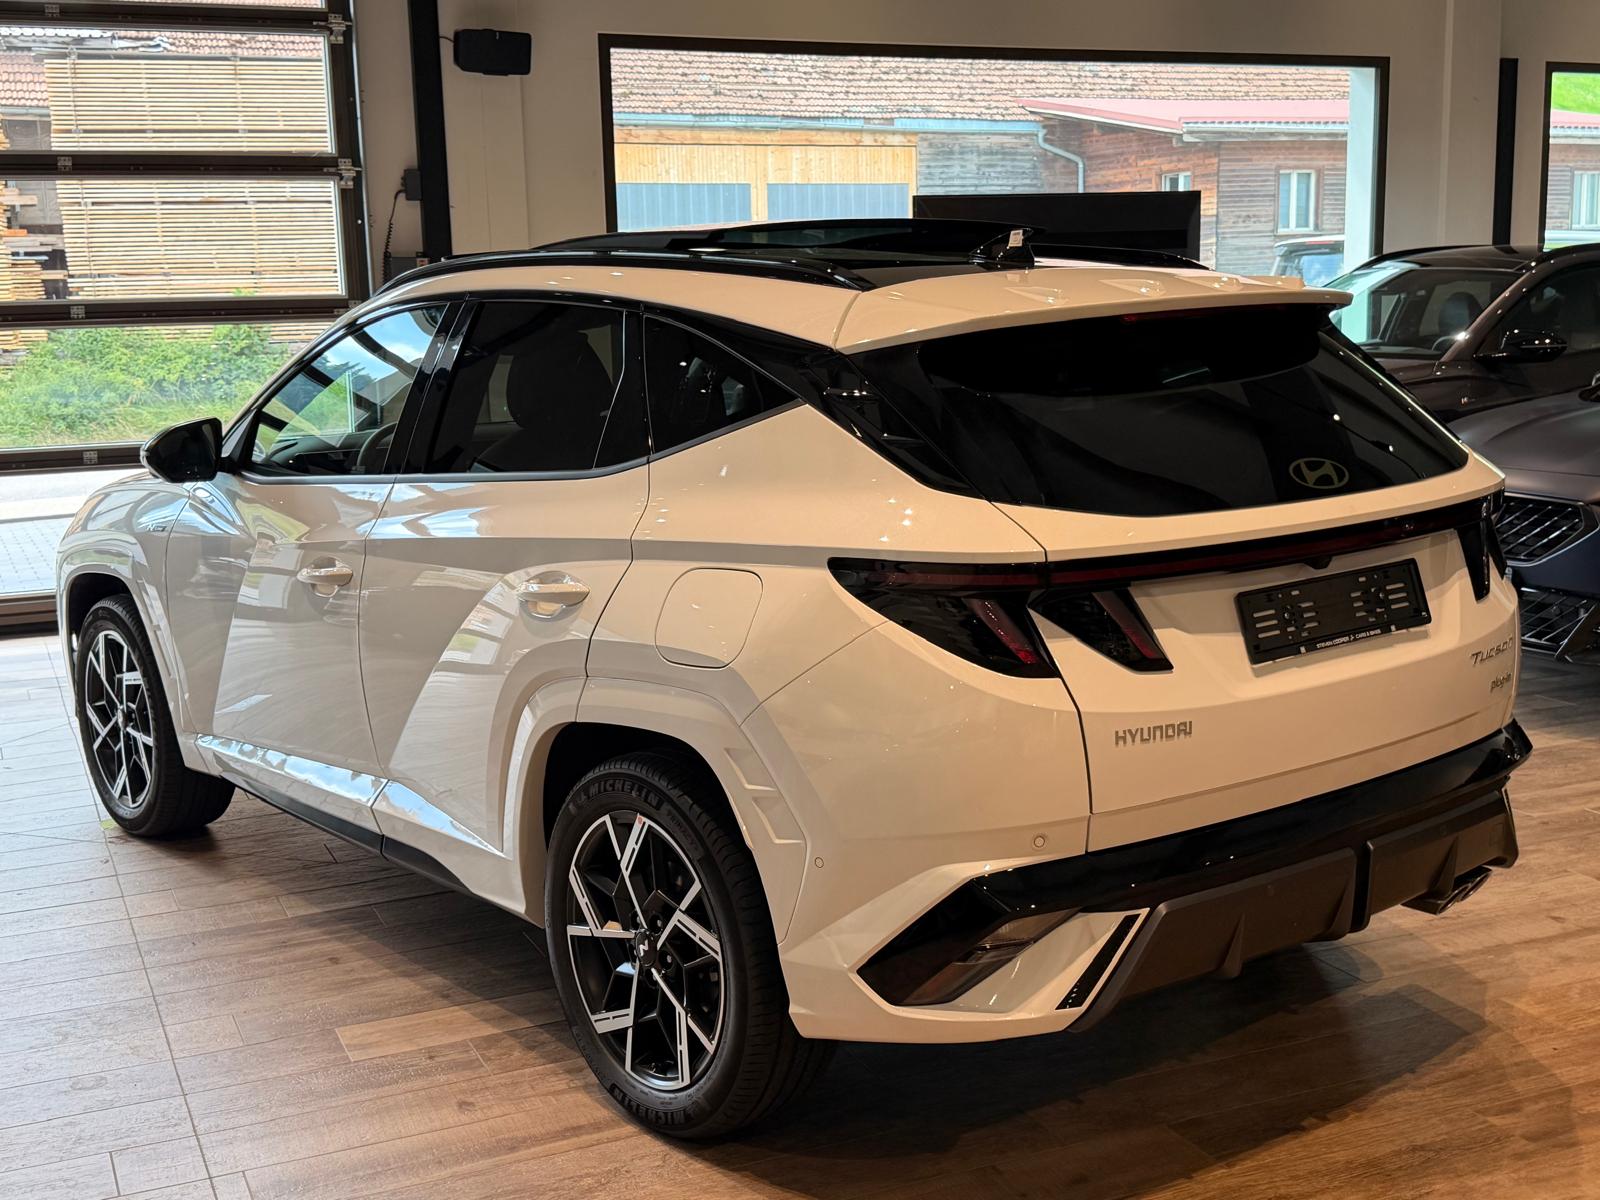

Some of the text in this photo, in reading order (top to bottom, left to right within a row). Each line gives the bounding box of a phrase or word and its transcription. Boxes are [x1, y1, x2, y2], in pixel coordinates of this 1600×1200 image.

[1114, 721, 1193, 746] HYUNDAI
[590, 780, 661, 808] MICHELIN
[614, 1087, 686, 1124] MICHELIN
